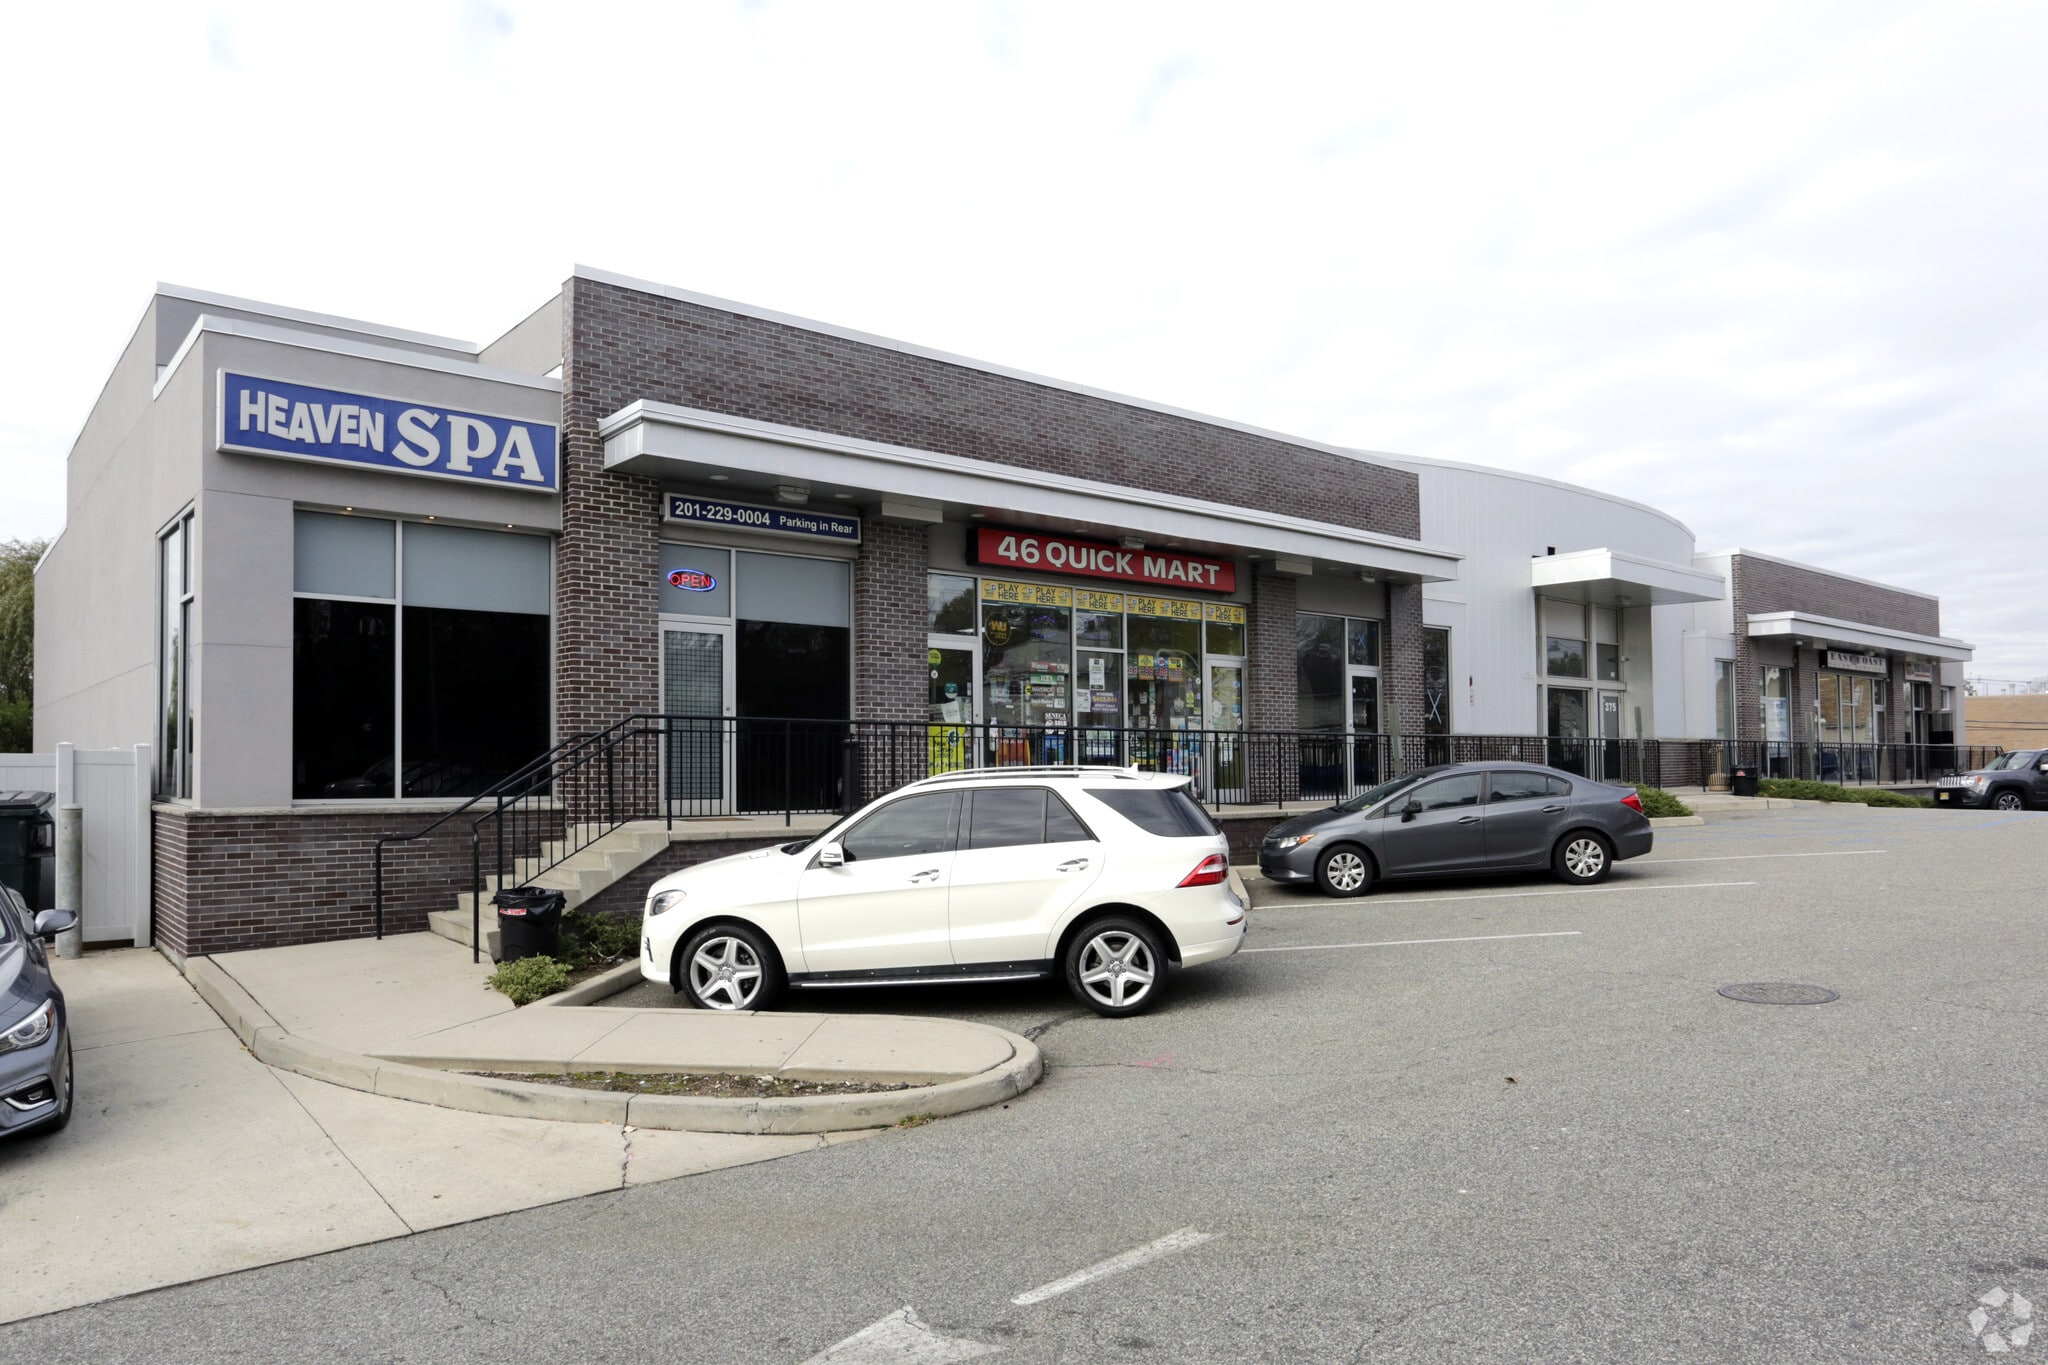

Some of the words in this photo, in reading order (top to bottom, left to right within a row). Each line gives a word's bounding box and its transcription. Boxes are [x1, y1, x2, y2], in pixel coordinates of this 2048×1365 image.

[239, 389, 385, 453] HEAVEN
[391, 408, 545, 482] SPA
[675, 501, 771, 526] 201-229-0004
[779, 516, 817, 532] Parking
[819, 520, 829, 532] in
[831, 522, 853, 534] Rear
[997, 535, 1041, 564] 46
[1045, 541, 1134, 575] QUICK
[1143, 555, 1220, 585] MART
[669, 573, 712, 588] OPEN
[998, 583, 1019, 592] PLAY
[1036, 587, 1057, 596] PLAY
[998, 591, 1019, 601] HERE
[1036, 595, 1056, 604] HERE
[1089, 593, 1109, 602] PLAY
[1089, 601, 1108, 610] HERE
[1138, 598, 1156, 607] PLAY
[1171, 601, 1189, 610] PLAY
[1138, 606, 1156, 615] HERE
[1171, 609, 1188, 618] HERE
[1215, 606, 1232, 614] PLAY
[1216, 613, 1231, 622] HERE
[1604, 702, 1617, 712] 375
